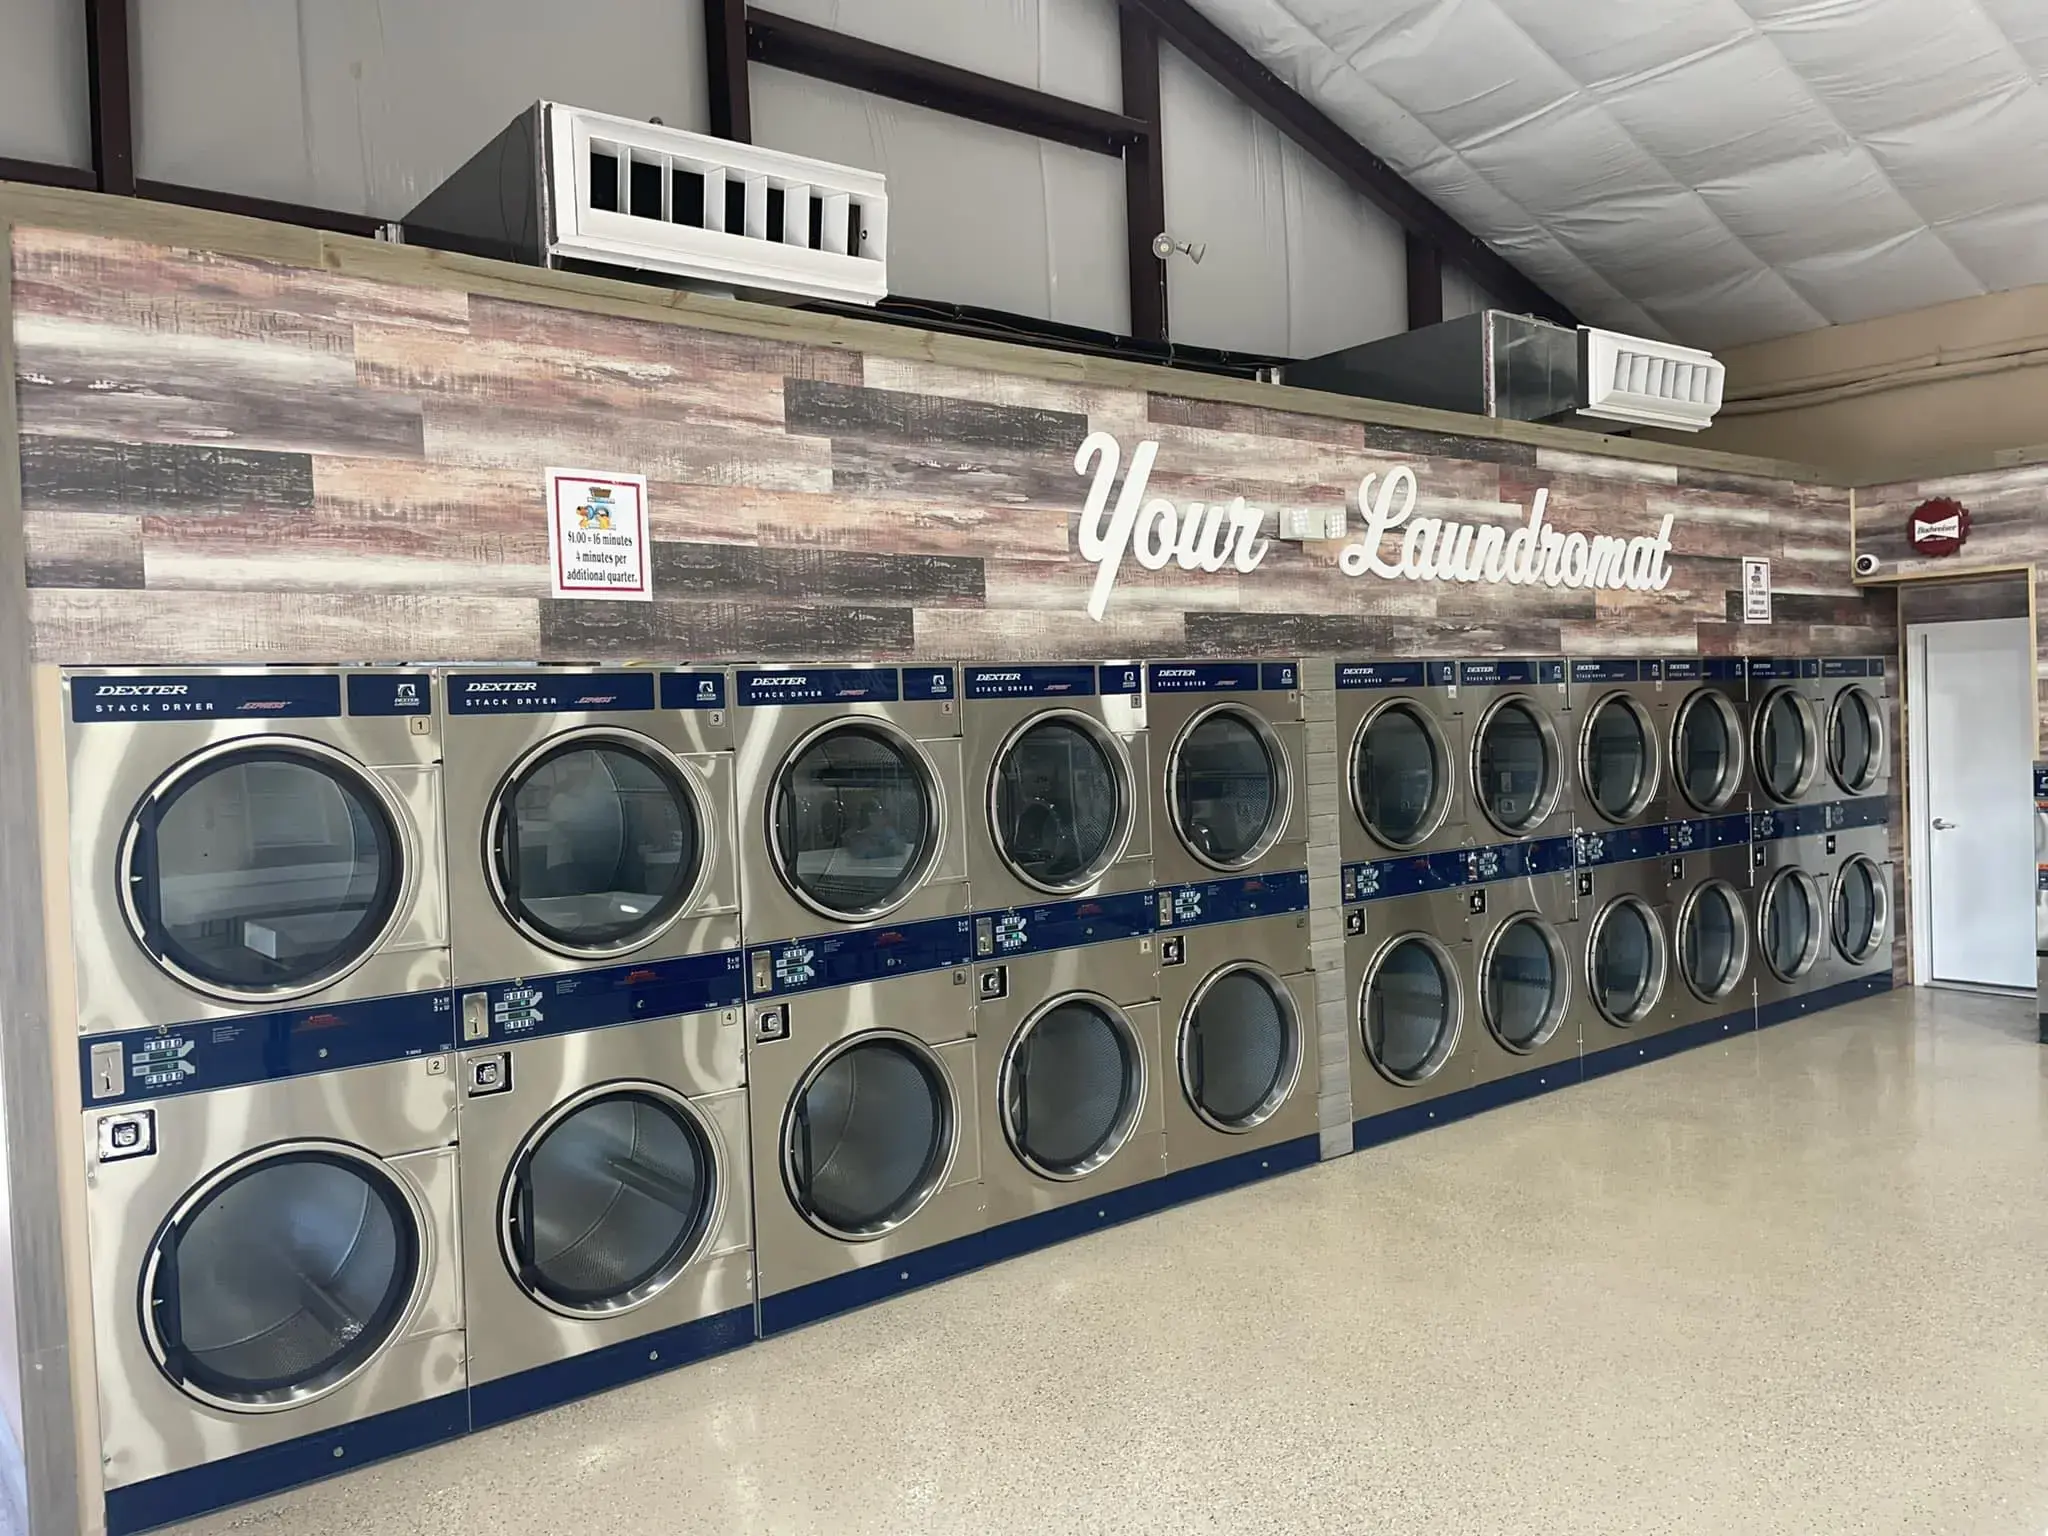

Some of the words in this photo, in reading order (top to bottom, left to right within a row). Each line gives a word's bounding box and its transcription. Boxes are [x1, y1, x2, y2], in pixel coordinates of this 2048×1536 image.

[1073, 431, 1270, 622] Your
[1339, 464, 1674, 592] Laundromat
[568, 530, 586, 543] $1.00
[593, 532, 601, 545] 16
[602, 533, 633, 547] minutes
[582, 550, 613, 564] minutes
[614, 554, 627, 567] per
[567, 568, 605, 581] additional
[607, 571, 638, 585] quarter.
[1158, 669, 1196, 677] DEXTER
[1343, 667, 1374, 675] DEXTER
[751, 676, 807, 687] DEXTER
[975, 672, 1021, 681] DEXTER
[95, 685, 188, 696] DEXTER
[465, 682, 537, 692] DEXTER
[975, 685, 1004, 694] STACK
[751, 691, 785, 699] STACK
[790, 690, 822, 698] DRYER
[466, 698, 508, 707] STACK
[517, 697, 557, 706] DRYER
[95, 703, 151, 713] STACK
[162, 702, 214, 712] DRYER
[713, 713, 719, 722] 3
[417, 720, 423, 730] 1
[726, 1012, 732, 1021] 4
[433, 1061, 440, 1070] 2
